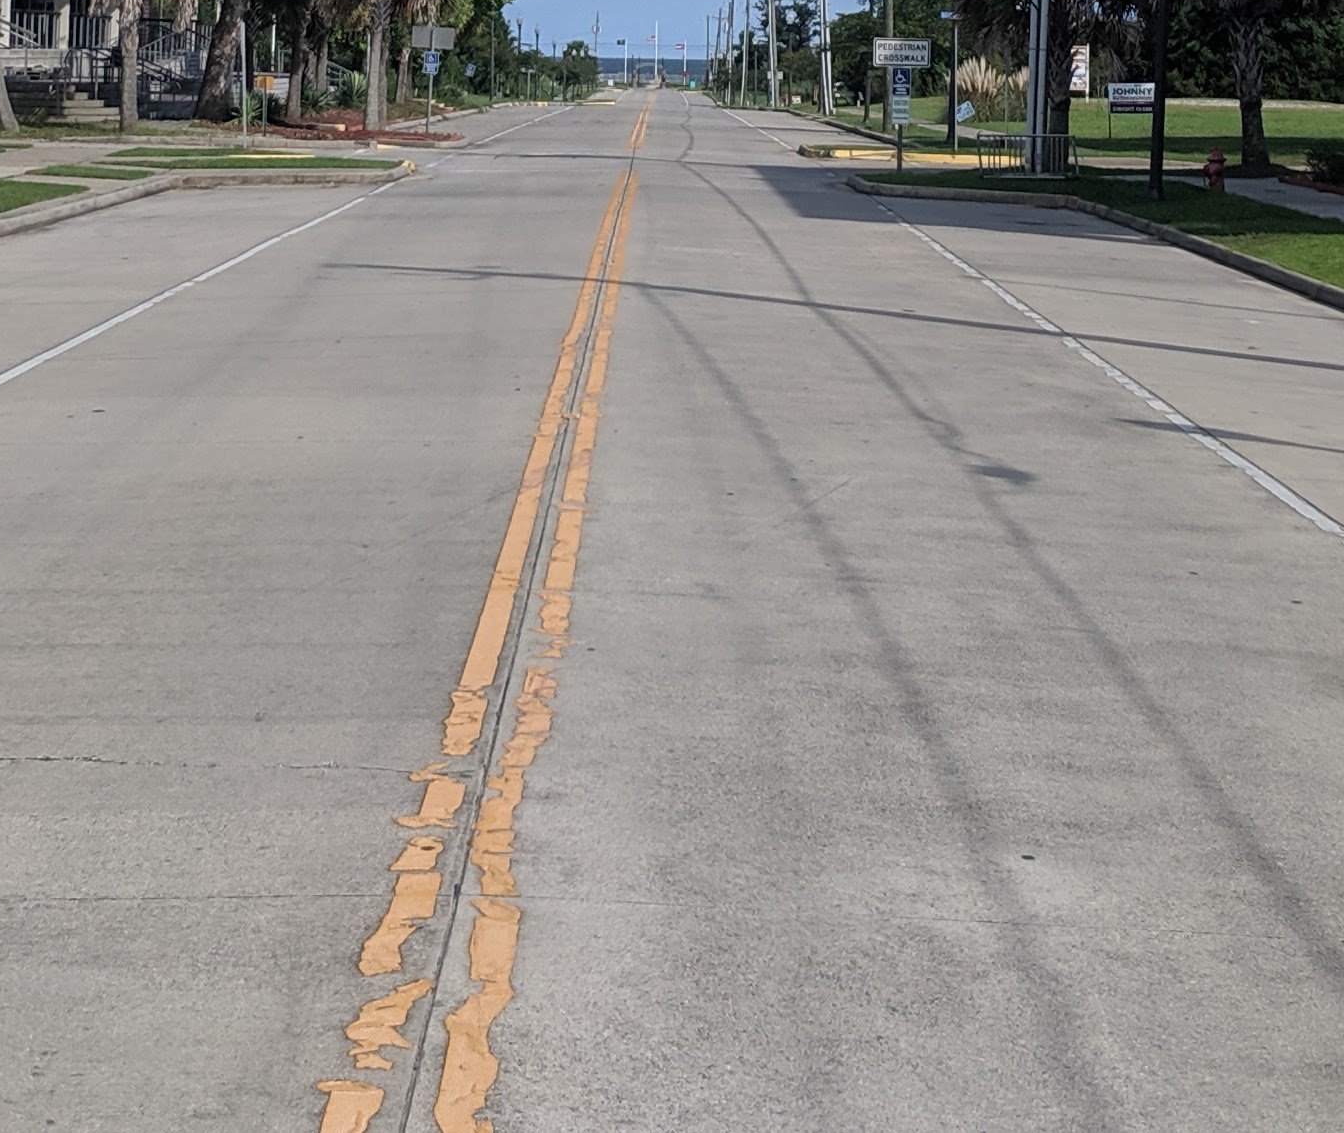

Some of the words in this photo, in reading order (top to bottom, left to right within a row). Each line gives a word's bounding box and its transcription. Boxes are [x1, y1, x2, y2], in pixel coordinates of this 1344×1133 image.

[877, 42, 927, 51] PEDESTRIAN
[877, 53, 926, 62] CROSSWALK
[1112, 87, 1152, 95] JOHNNY
